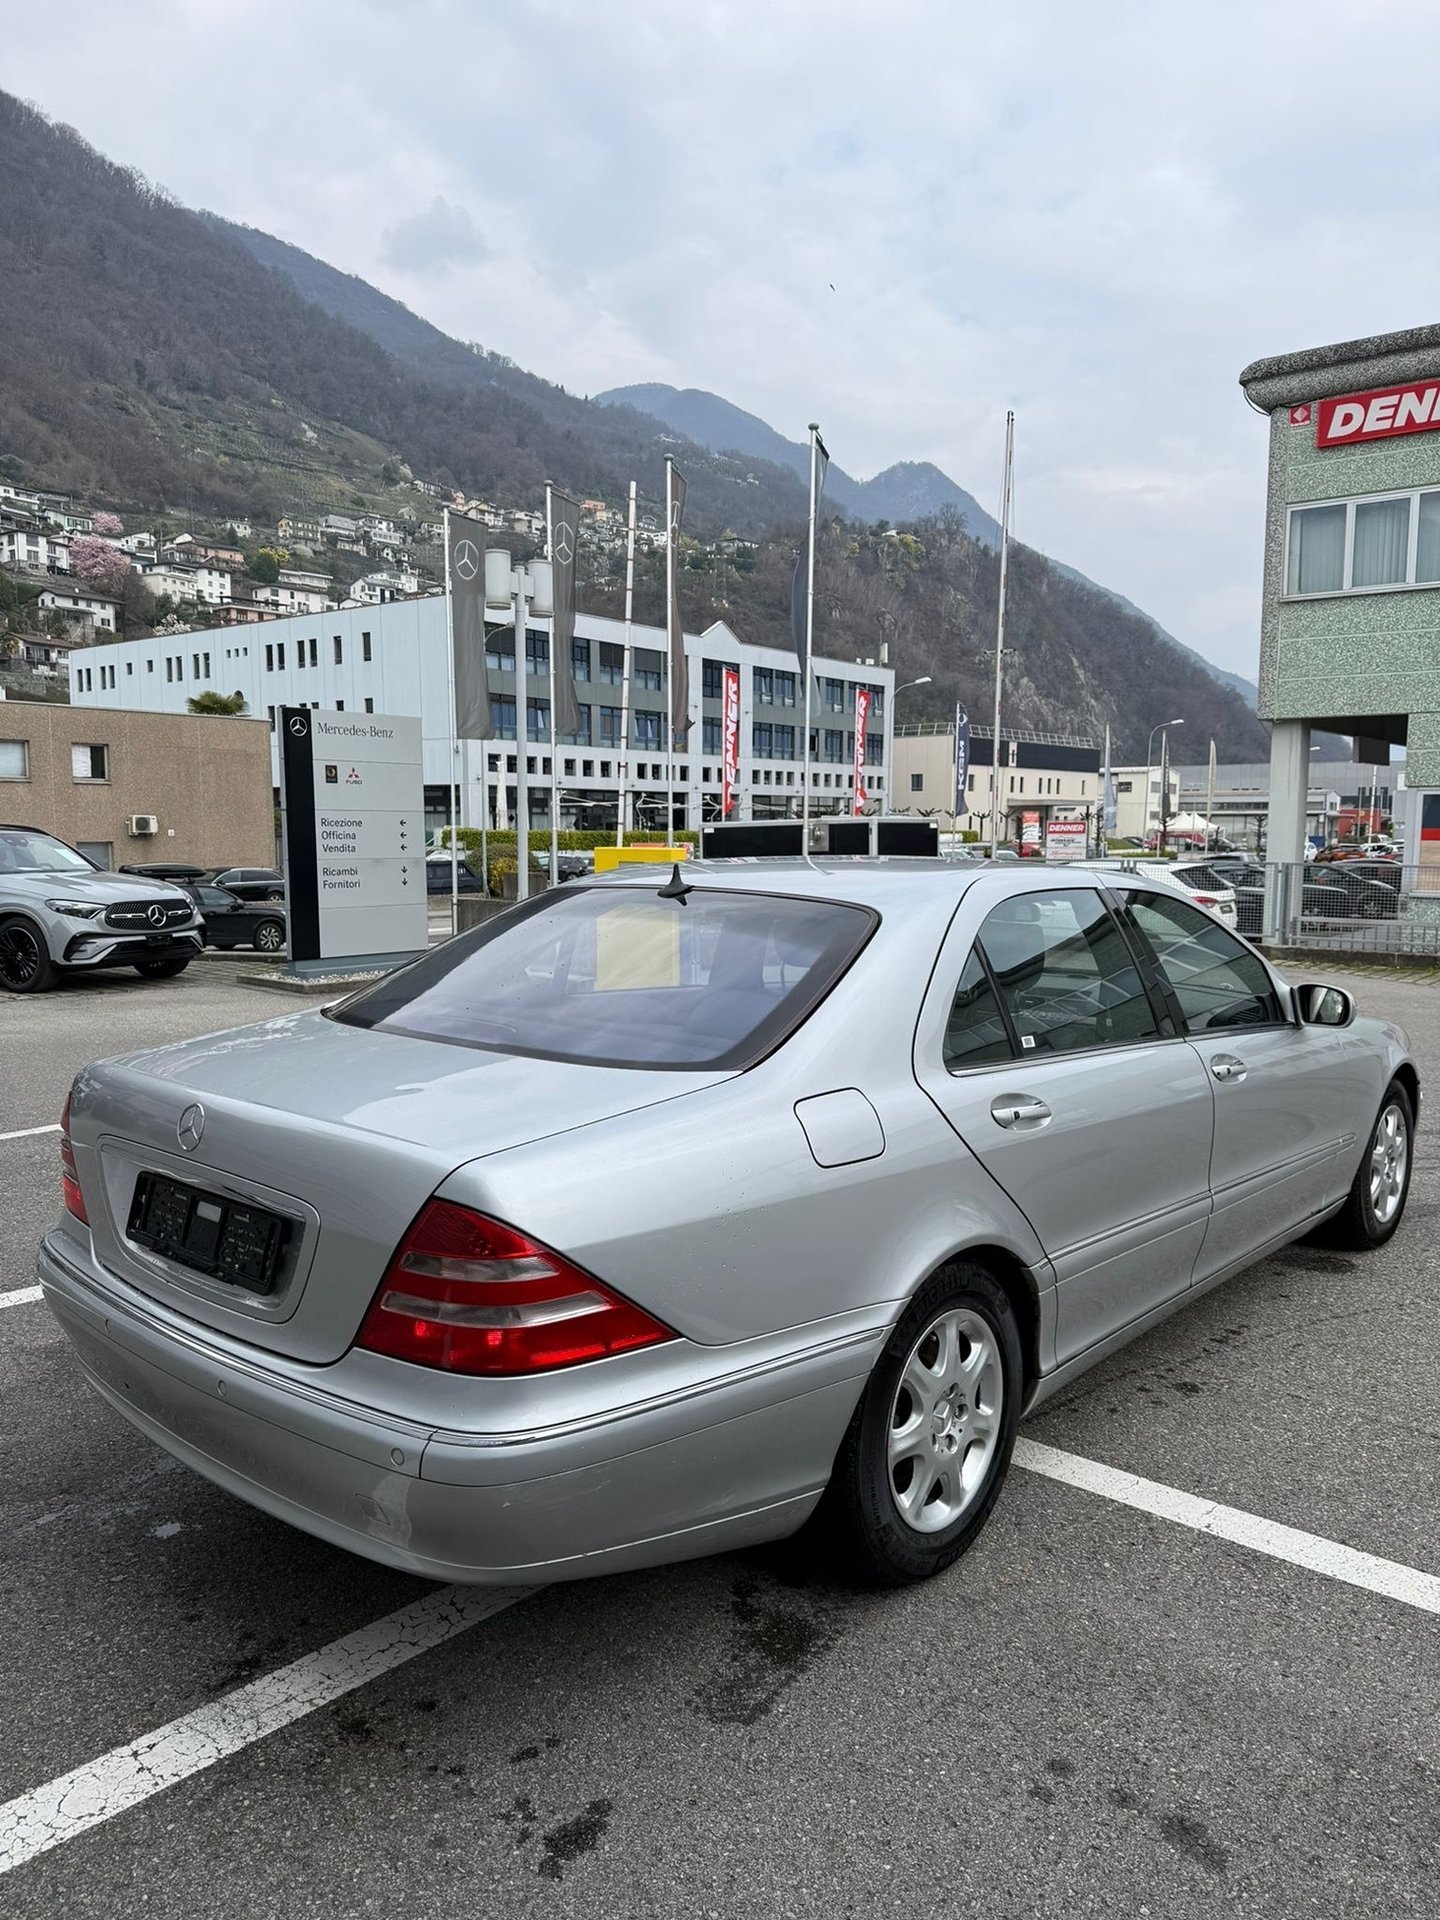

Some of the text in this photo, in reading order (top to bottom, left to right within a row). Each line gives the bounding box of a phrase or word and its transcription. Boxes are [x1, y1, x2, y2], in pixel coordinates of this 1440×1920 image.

[1327, 388, 1440, 438] DEN
[317, 722, 394, 738] Mercedes-Benz
[321, 818, 363, 827] Ricezione
[1049, 824, 1084, 832] DENNER
[321, 830, 356, 840] Officina
[322, 844, 356, 853] Vendita
[322, 867, 358, 876] Ricambi
[323, 879, 361, 889] Fornitori
